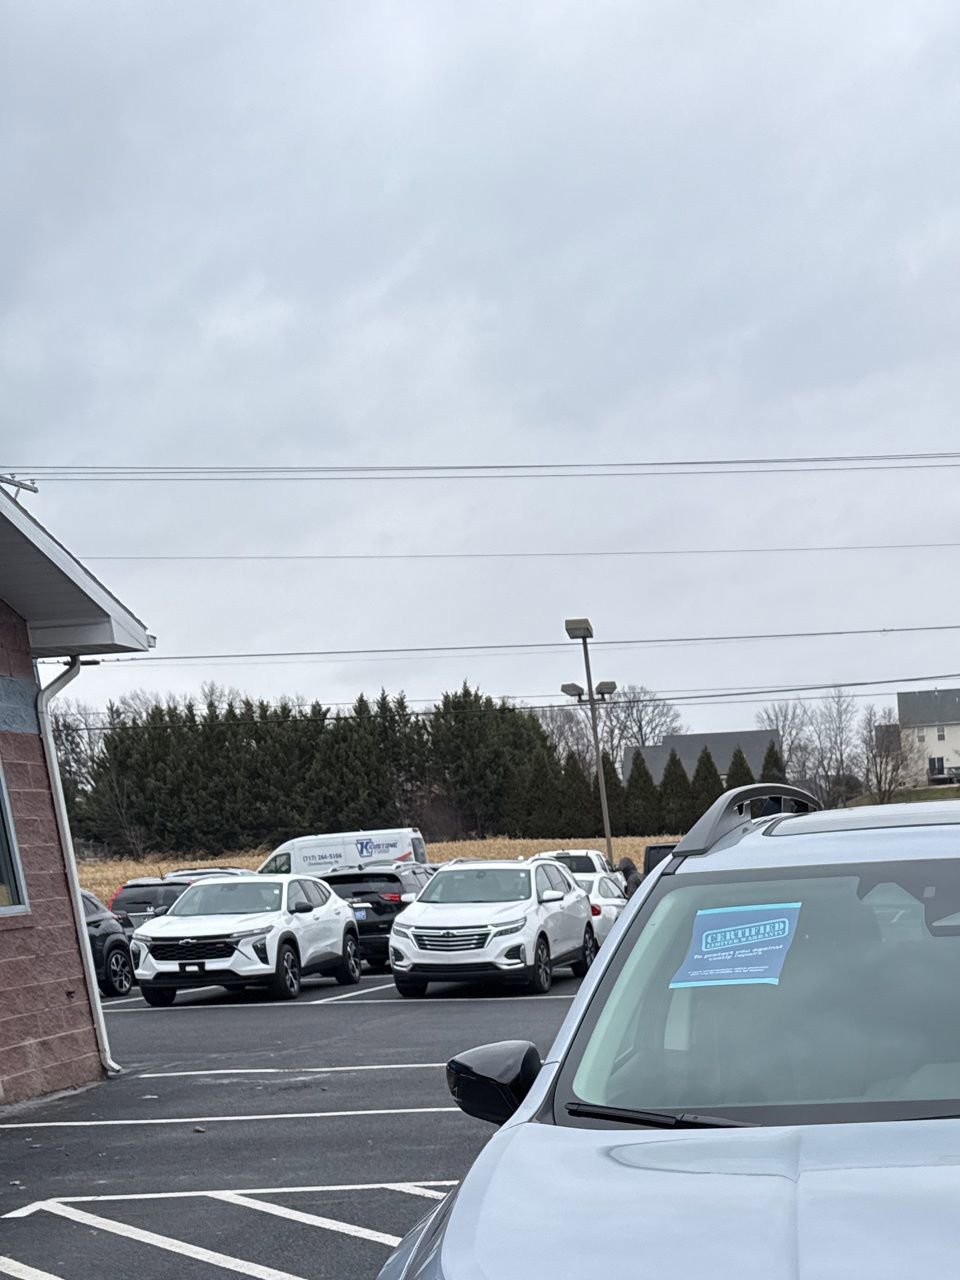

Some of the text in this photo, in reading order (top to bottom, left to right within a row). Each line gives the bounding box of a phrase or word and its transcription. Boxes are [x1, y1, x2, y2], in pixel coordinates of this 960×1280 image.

[706, 931, 783, 949] LIMITED WARRANTY
[707, 922, 784, 943] CERTIFIED
